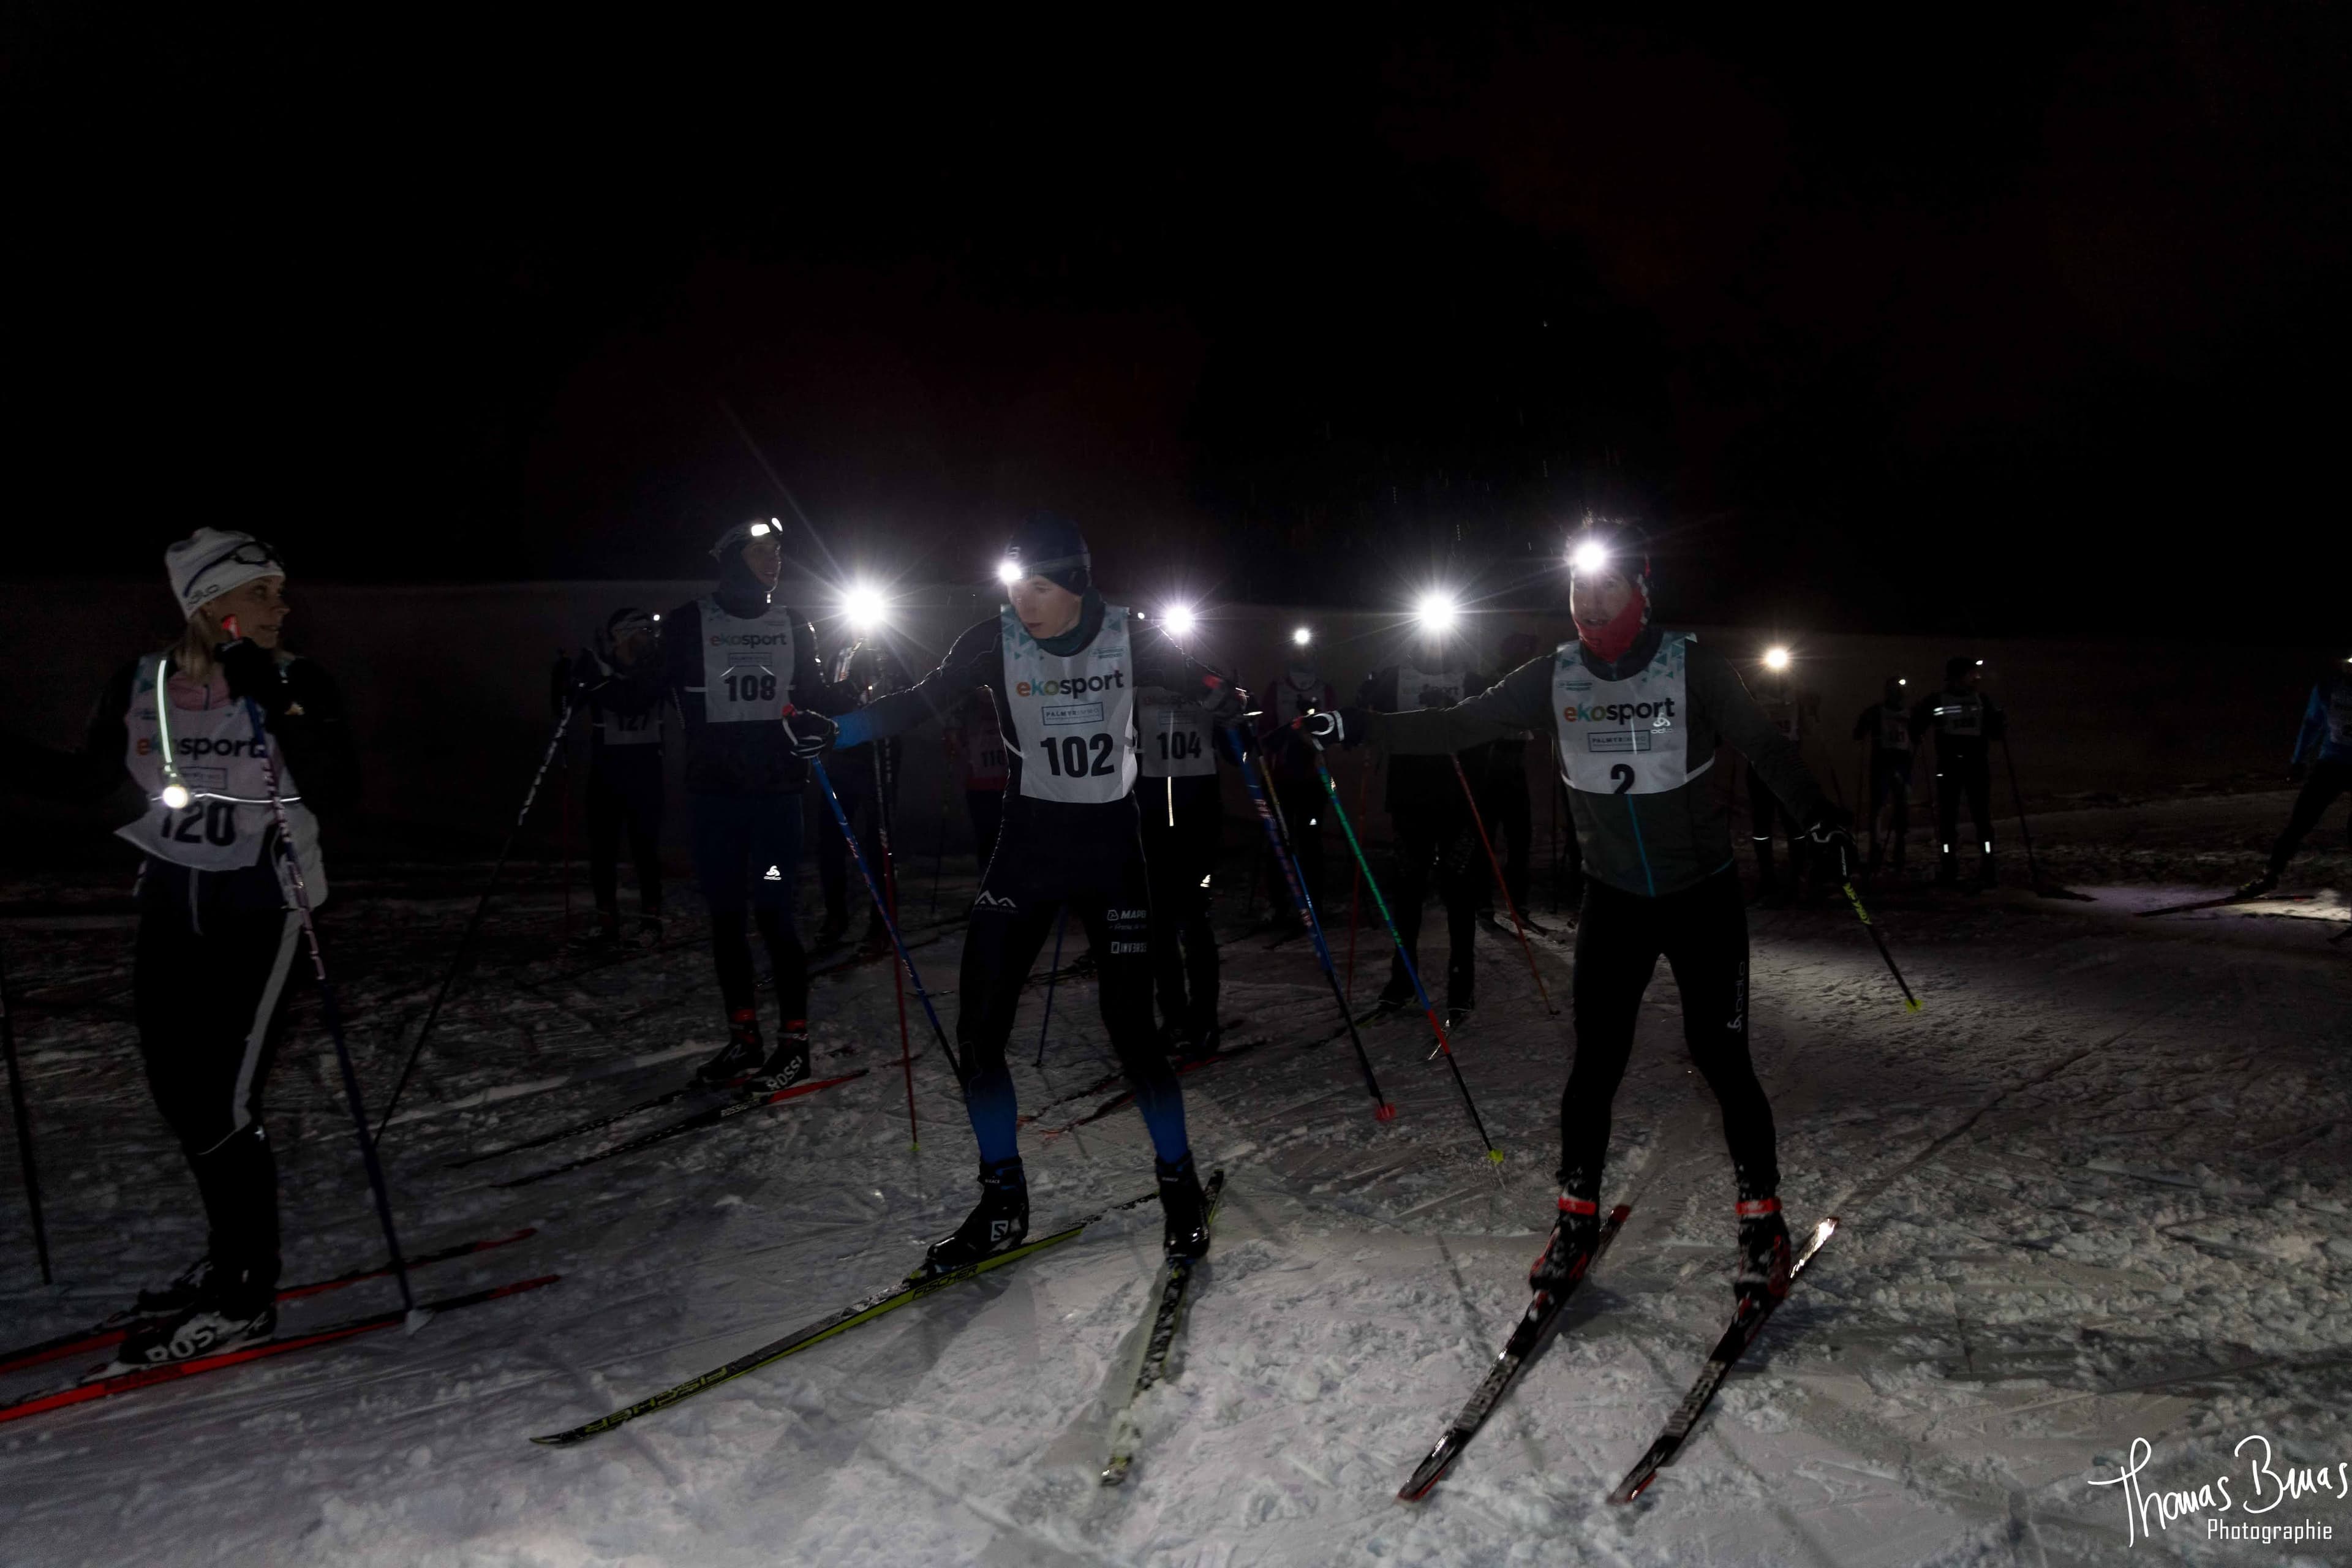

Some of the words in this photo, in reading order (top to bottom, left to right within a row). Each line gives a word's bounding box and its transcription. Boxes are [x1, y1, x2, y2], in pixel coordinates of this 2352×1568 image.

[709, 633, 787, 649] ekosport
[725, 675, 777, 701] 108
[1017, 670, 1124, 699] ekosport
[1563, 698, 1675, 725] ekosport
[1041, 733, 1115, 778] 102
[1157, 731, 1201, 760] 104
[1611, 764, 1634, 794] 2
[162, 802, 235, 846] 120
[766, 1055, 803, 1091] ROSSI
[913, 1265, 979, 1299] FISCHER
